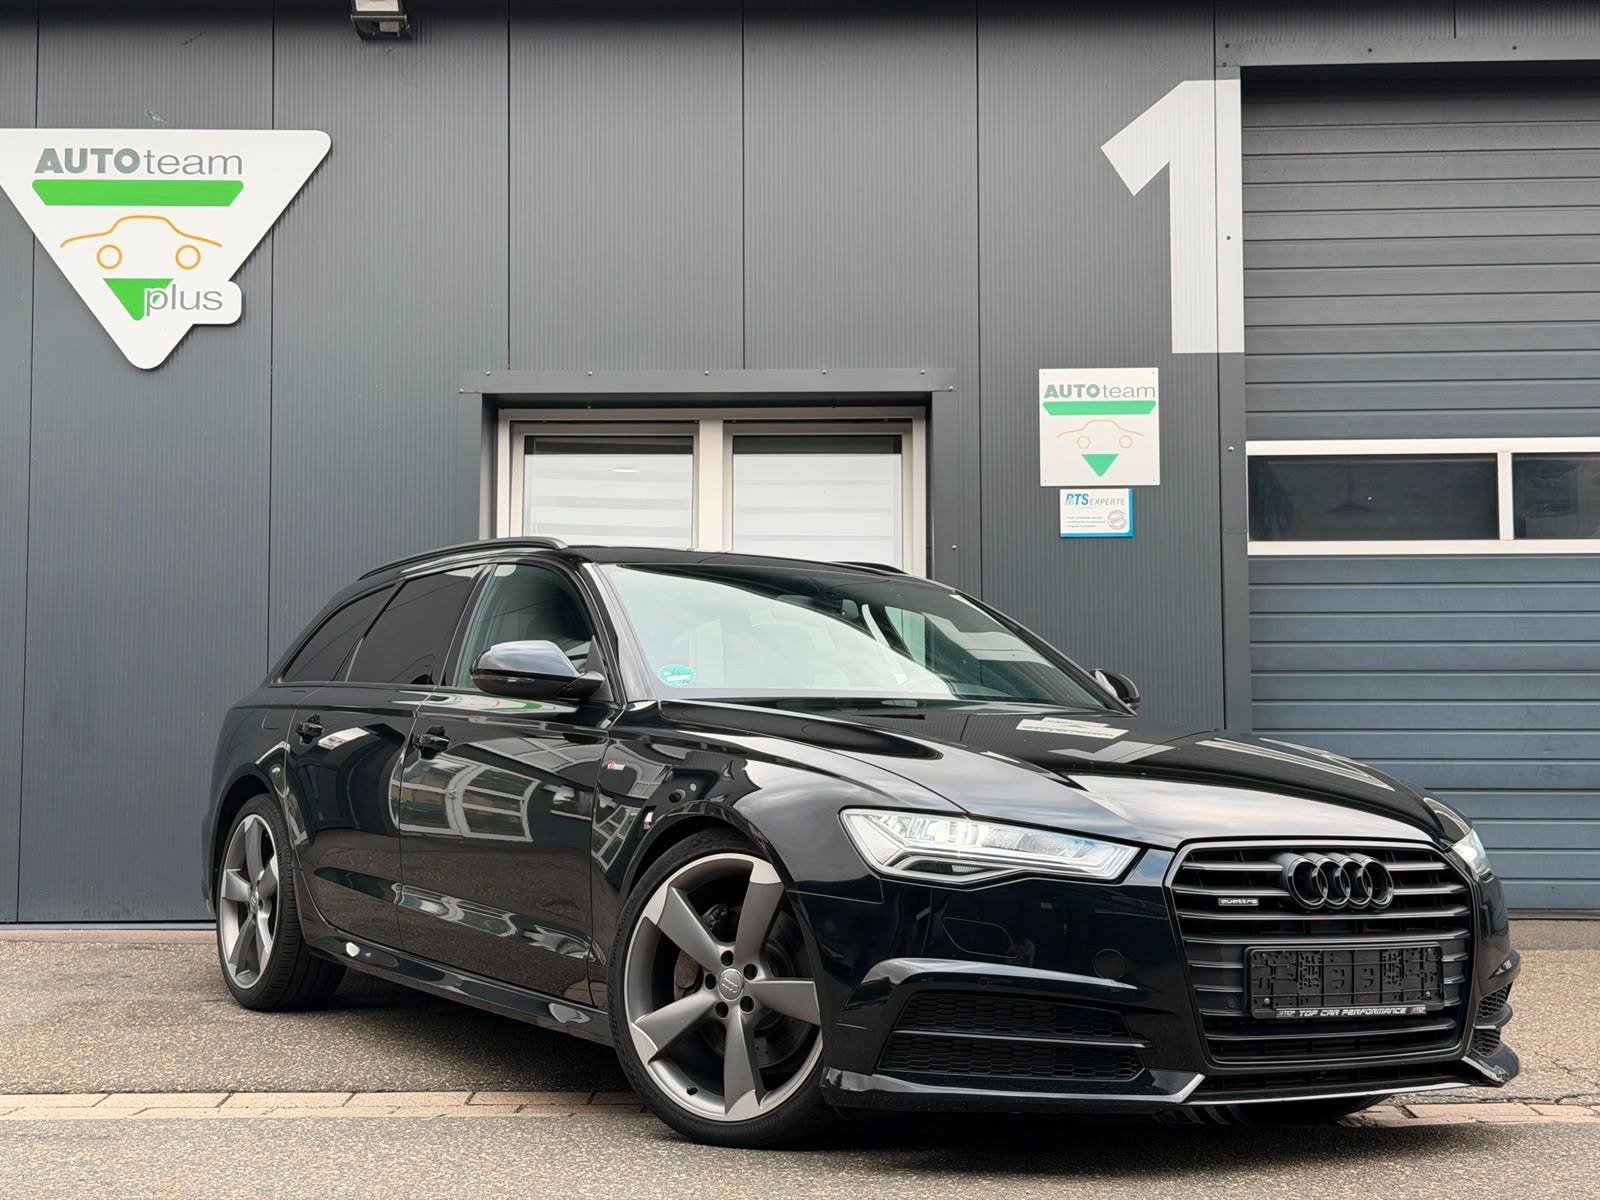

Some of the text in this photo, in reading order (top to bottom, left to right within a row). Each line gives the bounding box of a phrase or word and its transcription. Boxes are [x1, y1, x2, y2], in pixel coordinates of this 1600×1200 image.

[34, 147, 243, 175] AUTOteam
[1100, 79, 1245, 354] 1
[146, 284, 223, 317] plus
[1043, 383, 1156, 399] AUTOteam
[1299, 1009, 1319, 1017] TOP
[1320, 1009, 1340, 1017] CAR
[1341, 1007, 1407, 1016] PERFORMANCE
